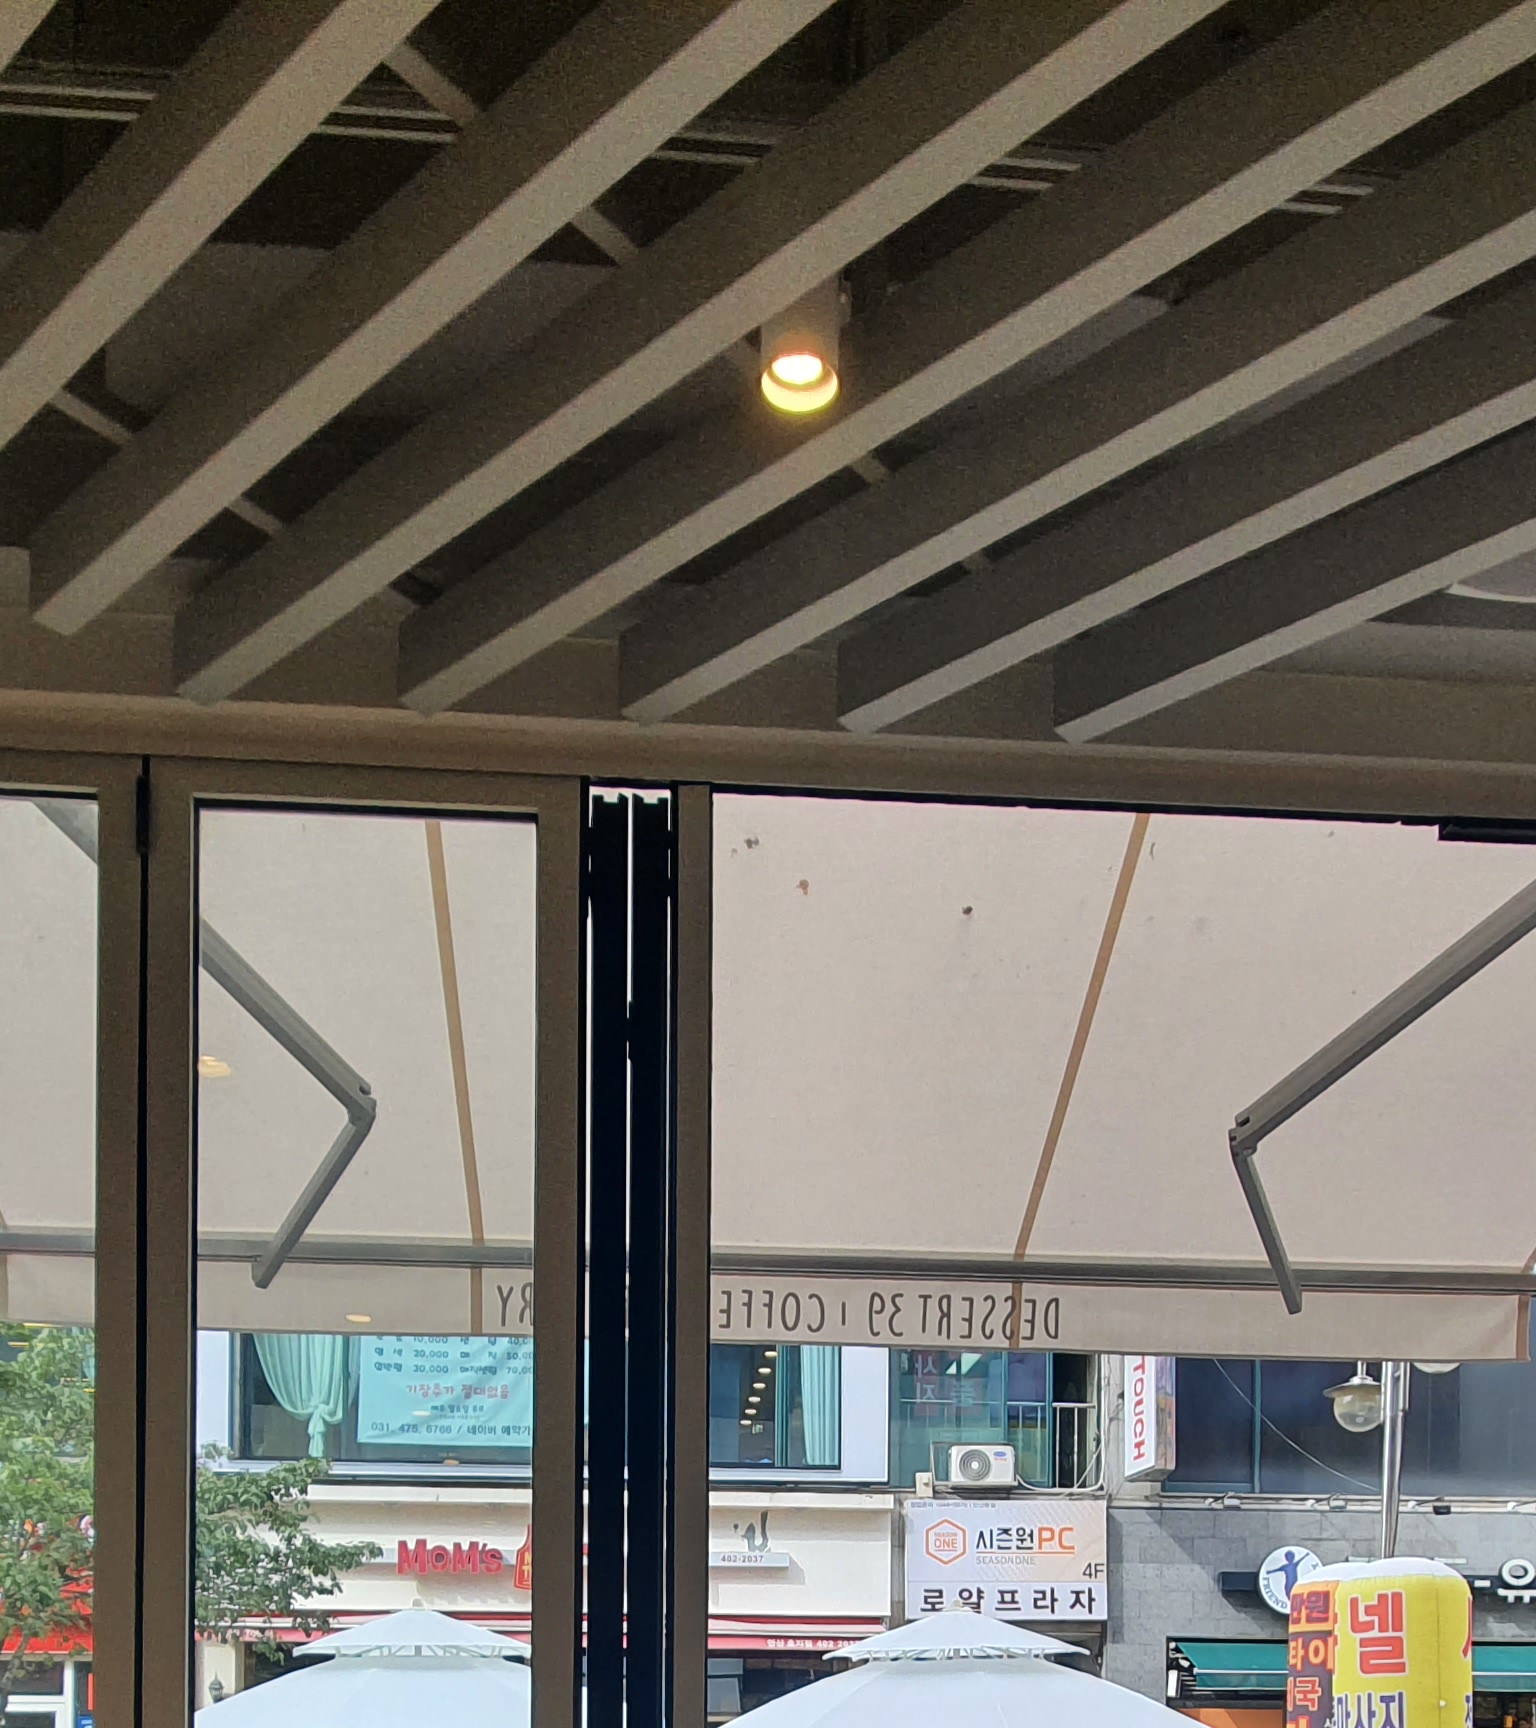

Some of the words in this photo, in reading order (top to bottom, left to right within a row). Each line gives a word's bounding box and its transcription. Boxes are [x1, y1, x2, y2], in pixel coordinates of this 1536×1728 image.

[467, 1424, 497, 1436] 네이버
[933, 1538, 958, 1549] ONE
[720, 1554, 765, 1564] 402-2037
[1082, 1563, 1105, 1580] 4F
